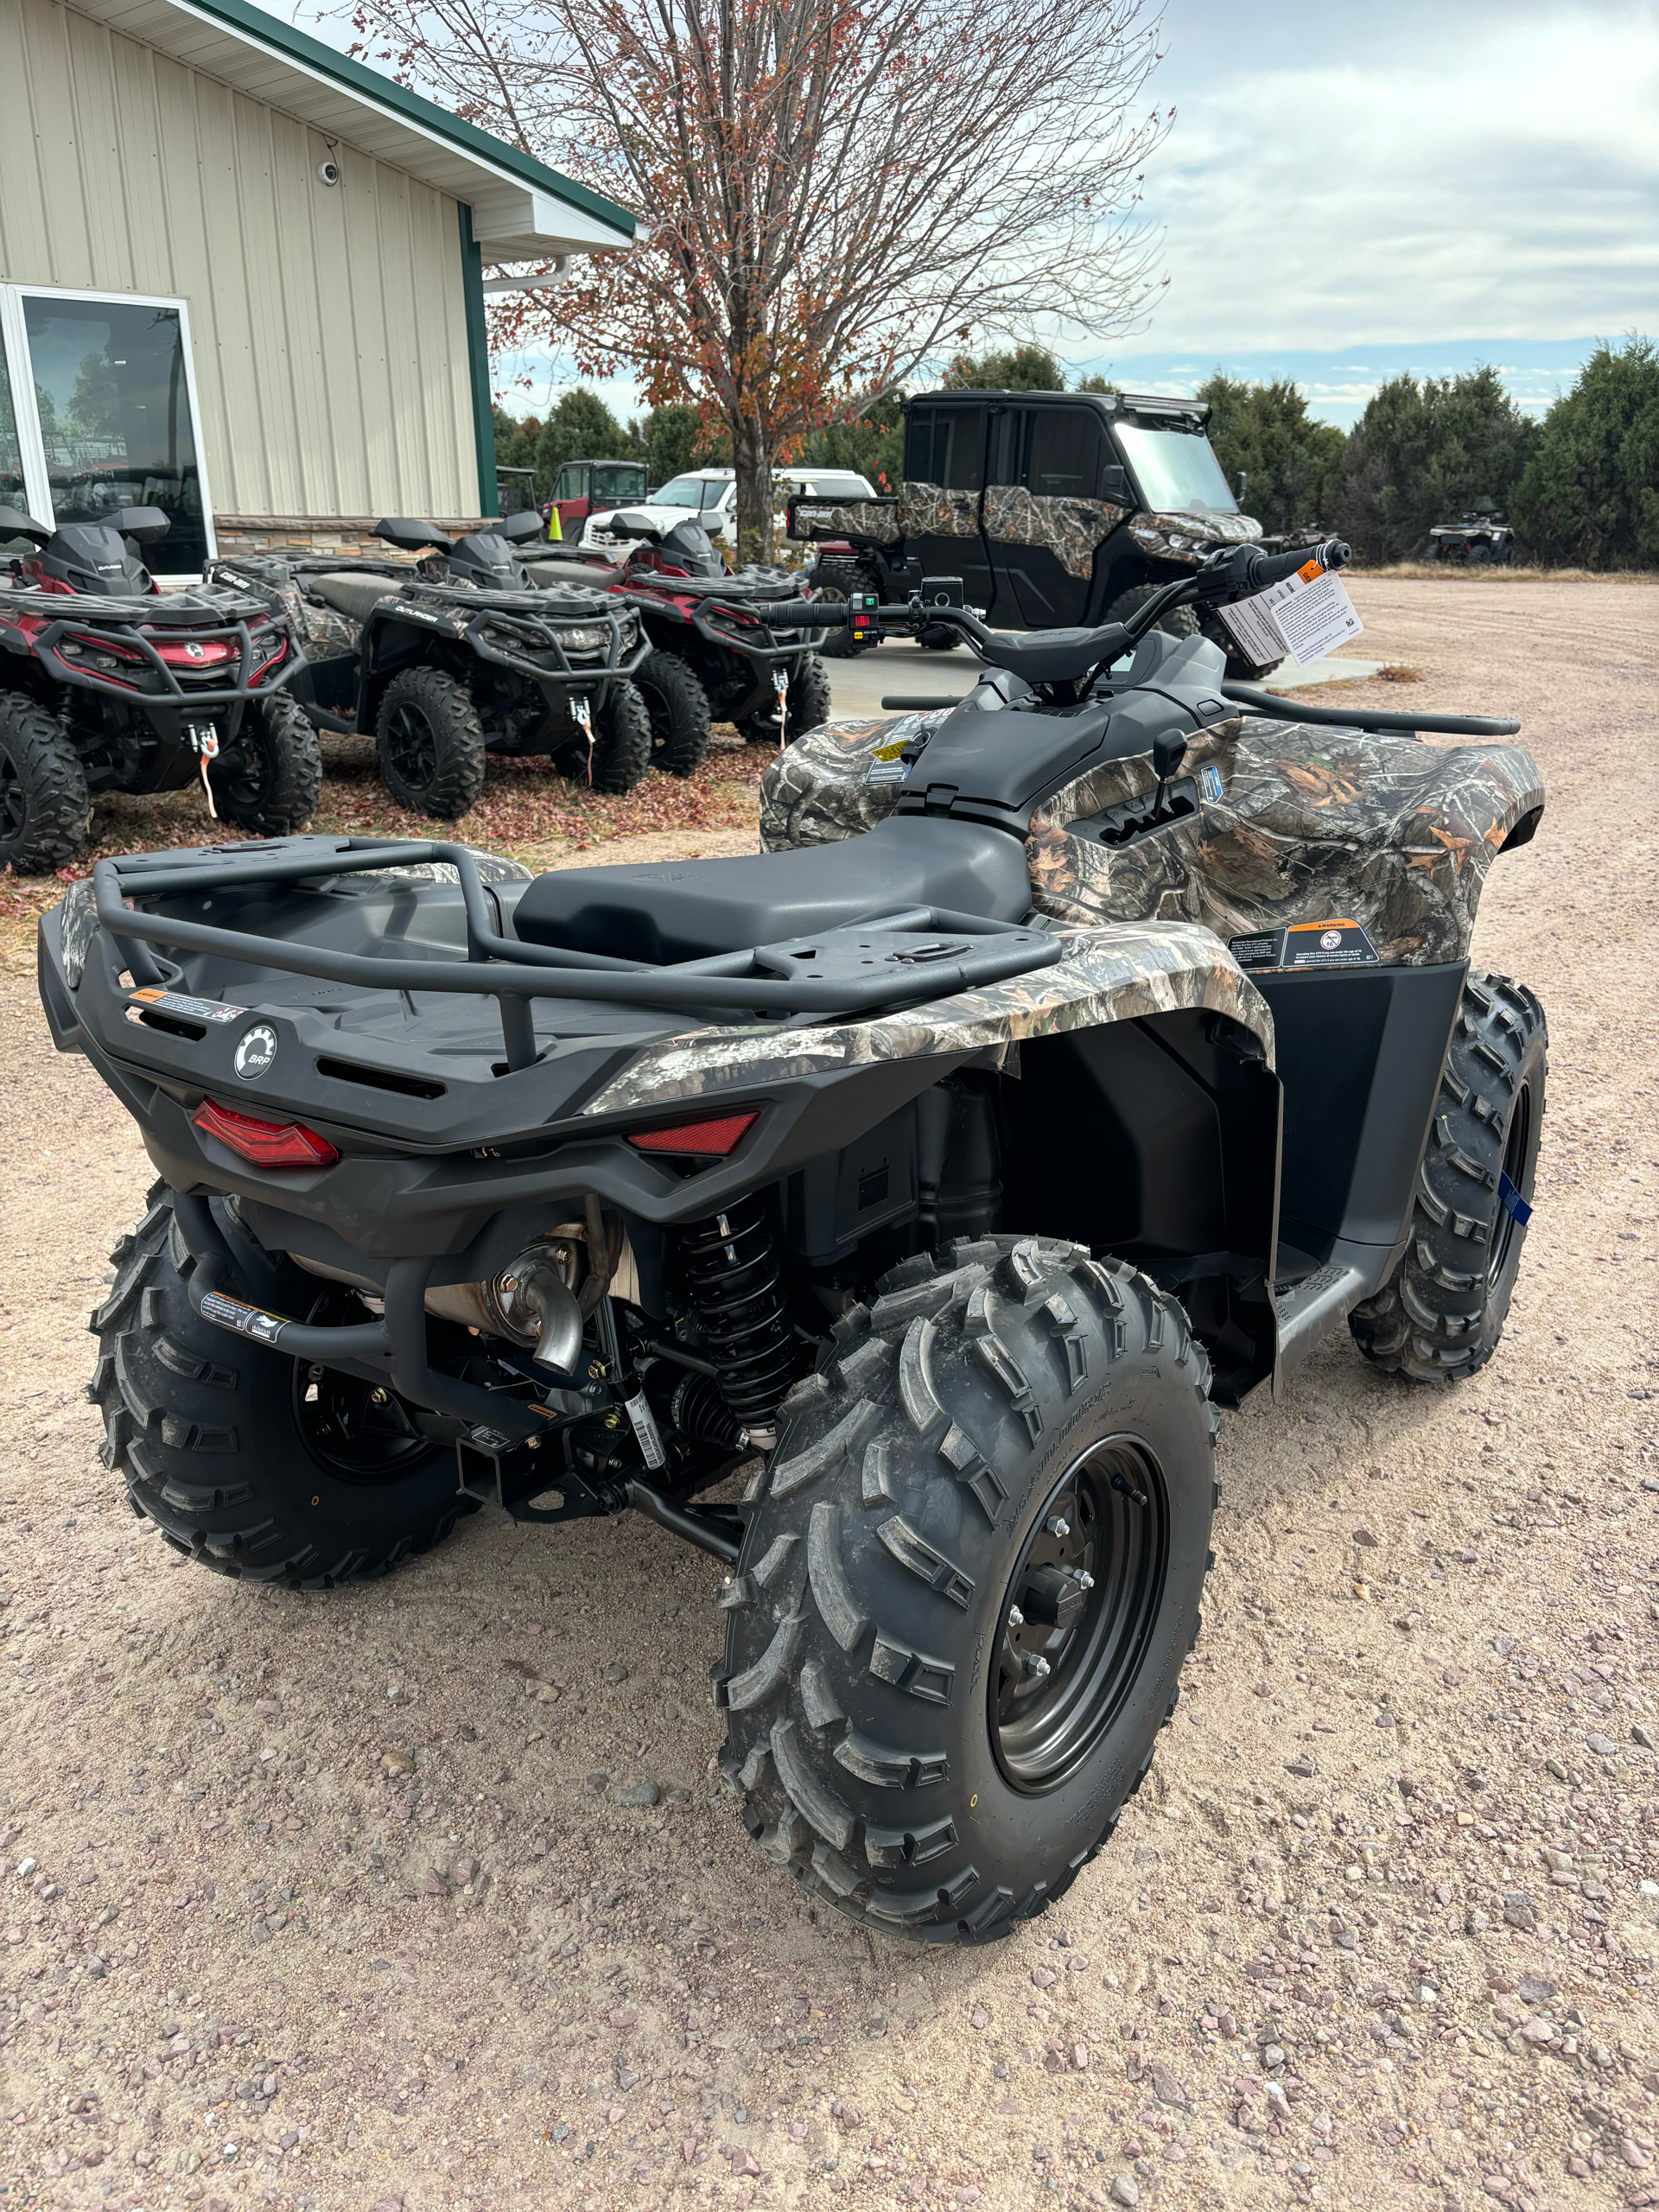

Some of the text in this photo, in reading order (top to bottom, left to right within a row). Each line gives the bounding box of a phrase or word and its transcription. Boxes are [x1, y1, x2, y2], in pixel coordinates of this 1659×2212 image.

[800, 510, 832, 518] can-am
[626, 594, 666, 608] OUTLANDER
[395, 605, 439, 622] OUTLANDER
[248, 1054, 270, 1065] BRP
